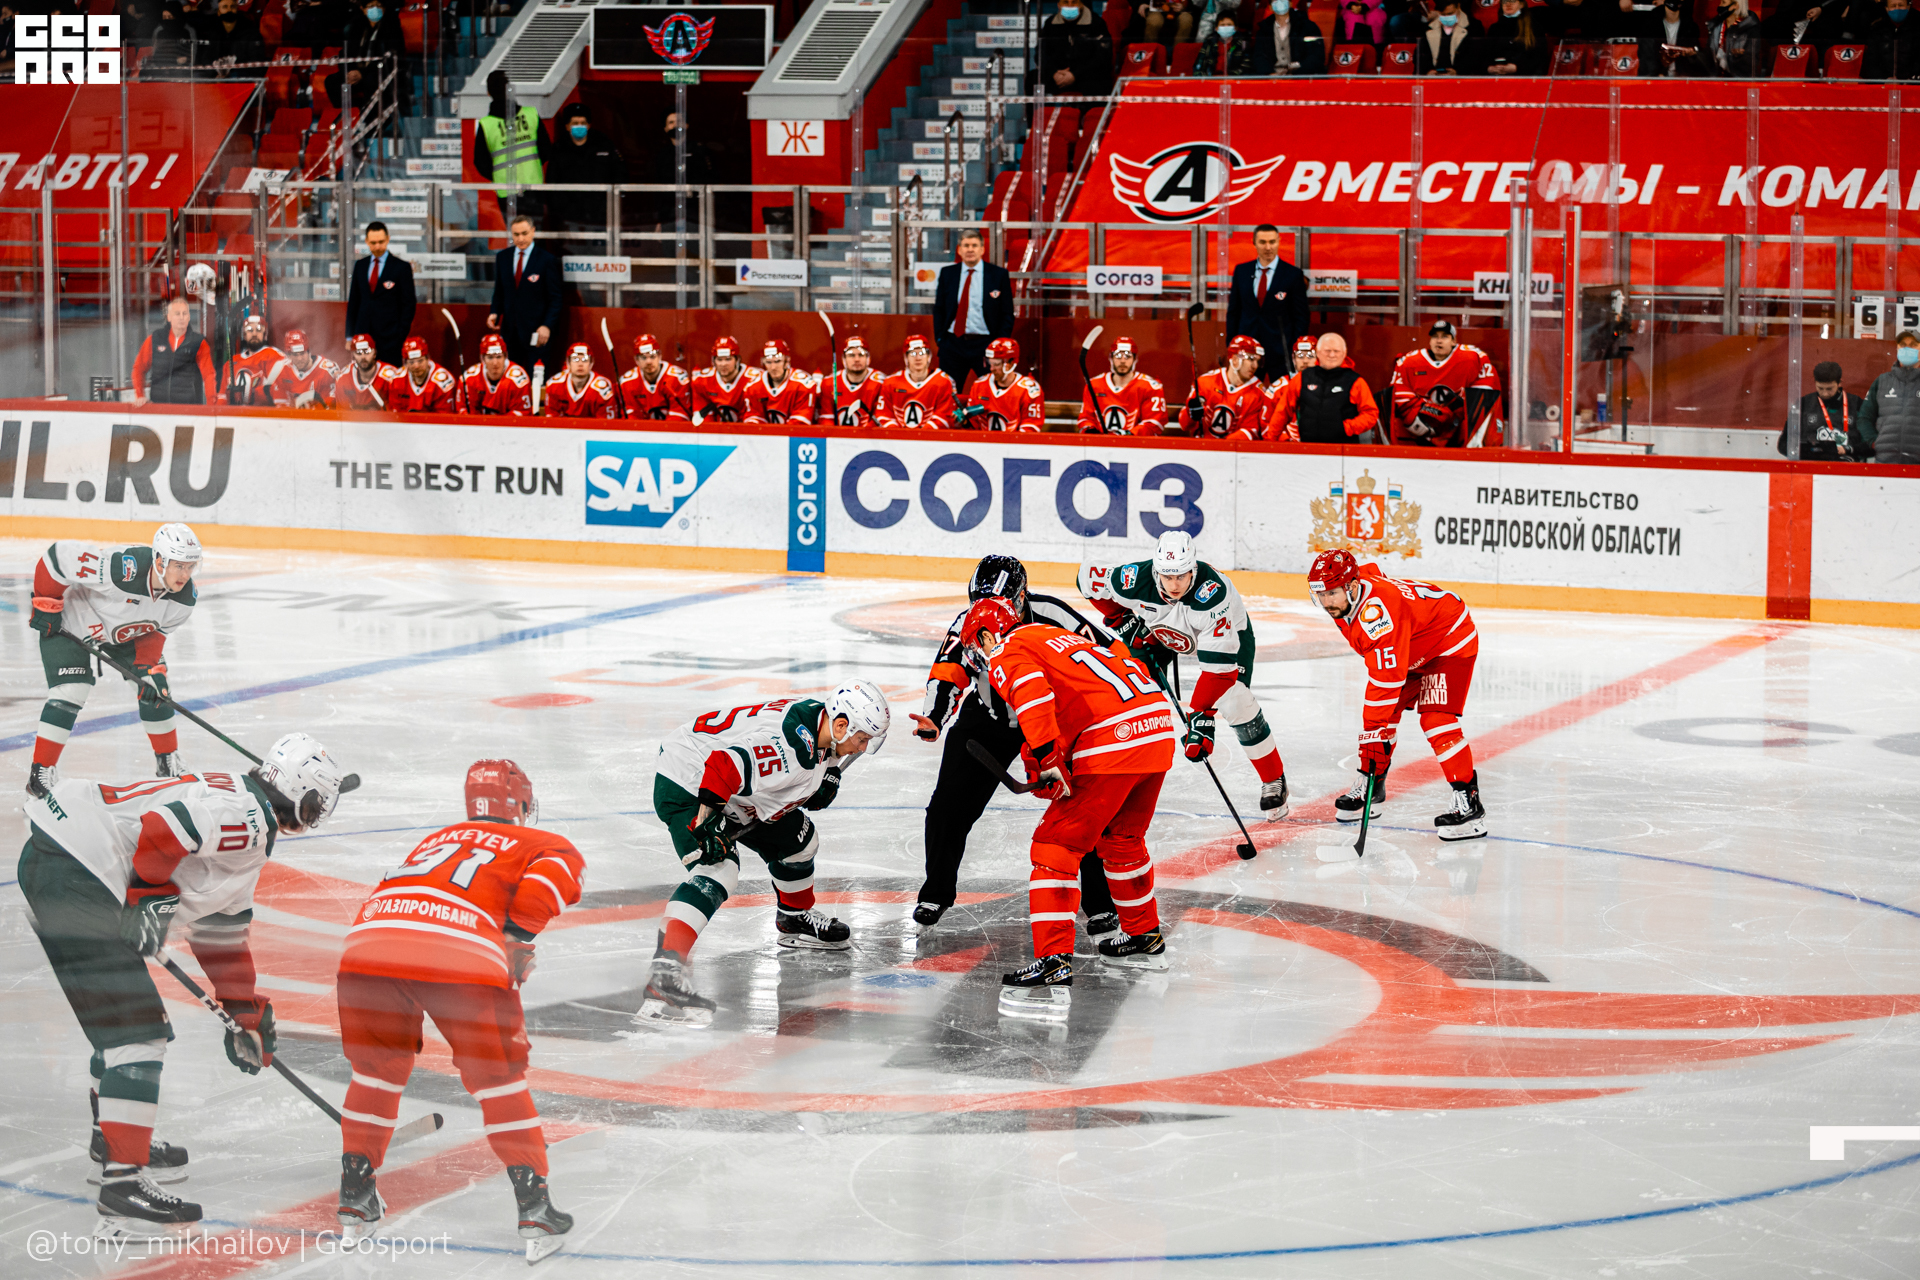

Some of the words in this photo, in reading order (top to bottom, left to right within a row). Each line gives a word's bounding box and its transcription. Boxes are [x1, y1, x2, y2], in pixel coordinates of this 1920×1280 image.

[1283, 160, 1537, 204] ВМЕСТЕ
[563, 262, 627, 274] SIMA-LAND
[751, 271, 803, 281] Ростелеком
[1861, 305, 1878, 327] 6
[1903, 306, 1919, 327] 5
[1151, 396, 1167, 412] 23
[330, 461, 392, 490] THE
[403, 462, 485, 493] BEST
[495, 466, 563, 496] RUN
[586, 454, 698, 514] SAP
[1476, 486, 1639, 511] ПРАВИТЕЛЬСТВО
[1434, 515, 1585, 552] СВЕРДЛОВСКОЙ
[1592, 522, 1681, 557] ОБЛАСТИ
[76, 551, 99, 578] 44
[1166, 551, 1175, 560] 24
[1045, 634, 1097, 654] DATS
[1374, 646, 1397, 670] 15
[1420, 673, 1447, 690] SIMA
[1418, 689, 1448, 705] LAND
[753, 744, 782, 777] 95
[475, 799, 489, 816] 91
[216, 821, 250, 852] 10
[417, 829, 518, 852] MAKEYEV
[384, 842, 496, 891] 91
[379, 898, 479, 930] ГАЗПРОМБАНК
